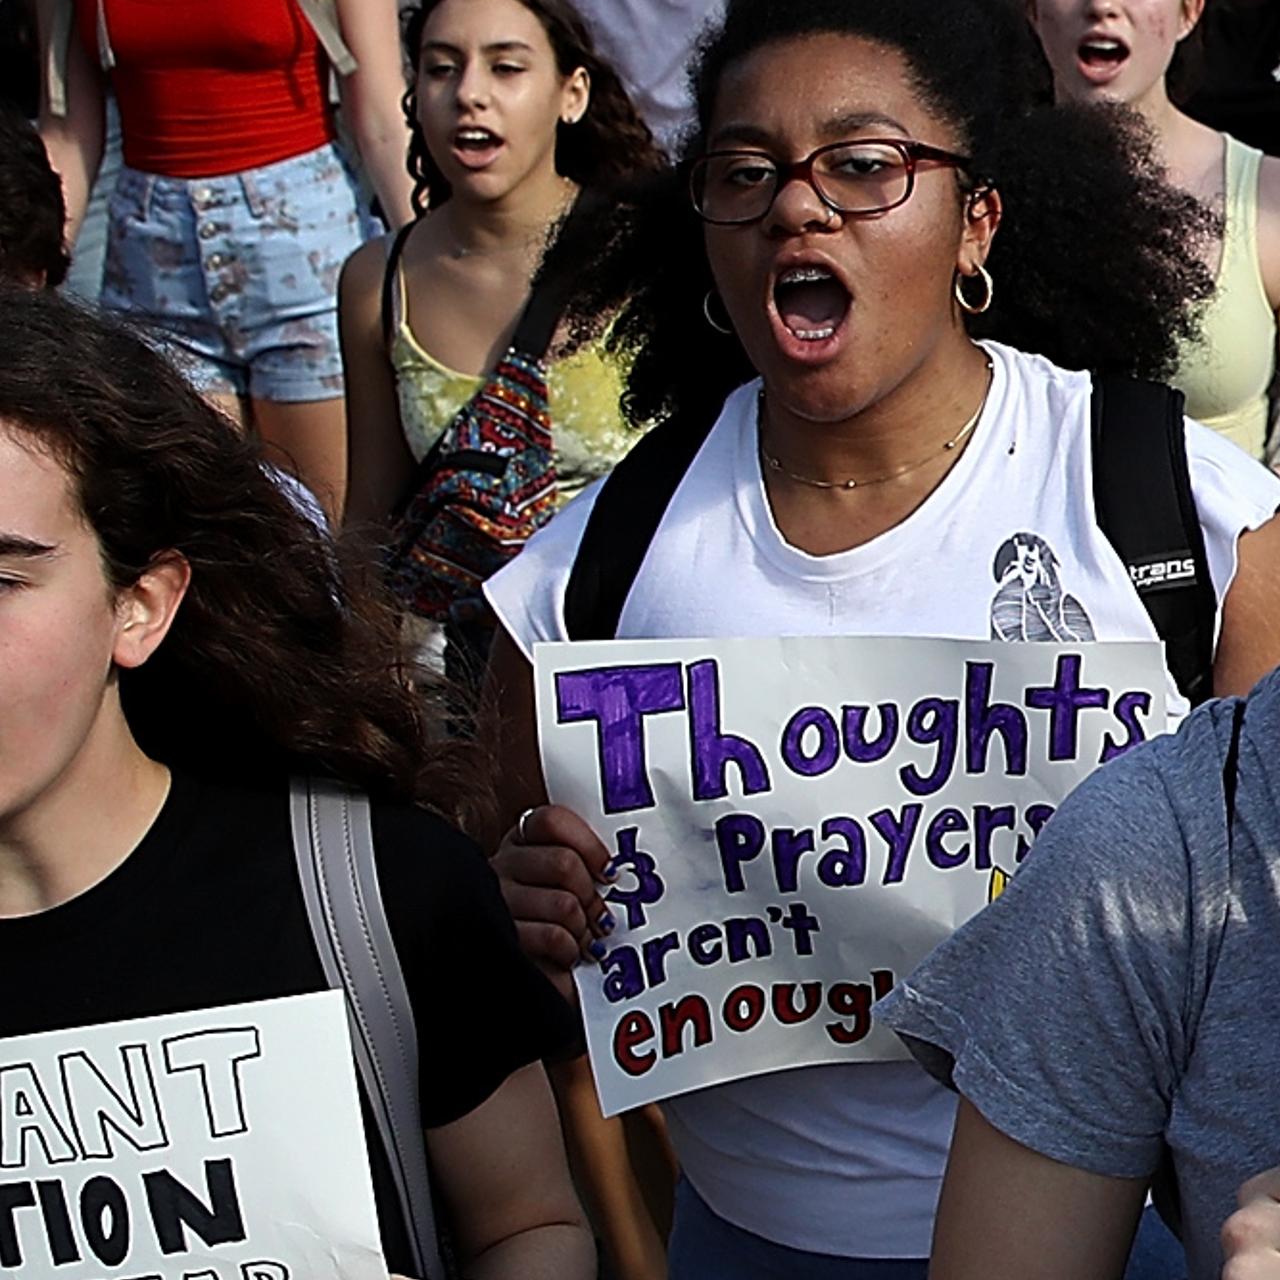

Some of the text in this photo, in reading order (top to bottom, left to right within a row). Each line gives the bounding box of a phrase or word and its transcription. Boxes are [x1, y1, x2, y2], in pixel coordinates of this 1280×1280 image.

[554, 654, 1153, 816] Thoughts
[714, 802, 1058, 895] Prayers
[601, 902, 820, 1005] aren't
